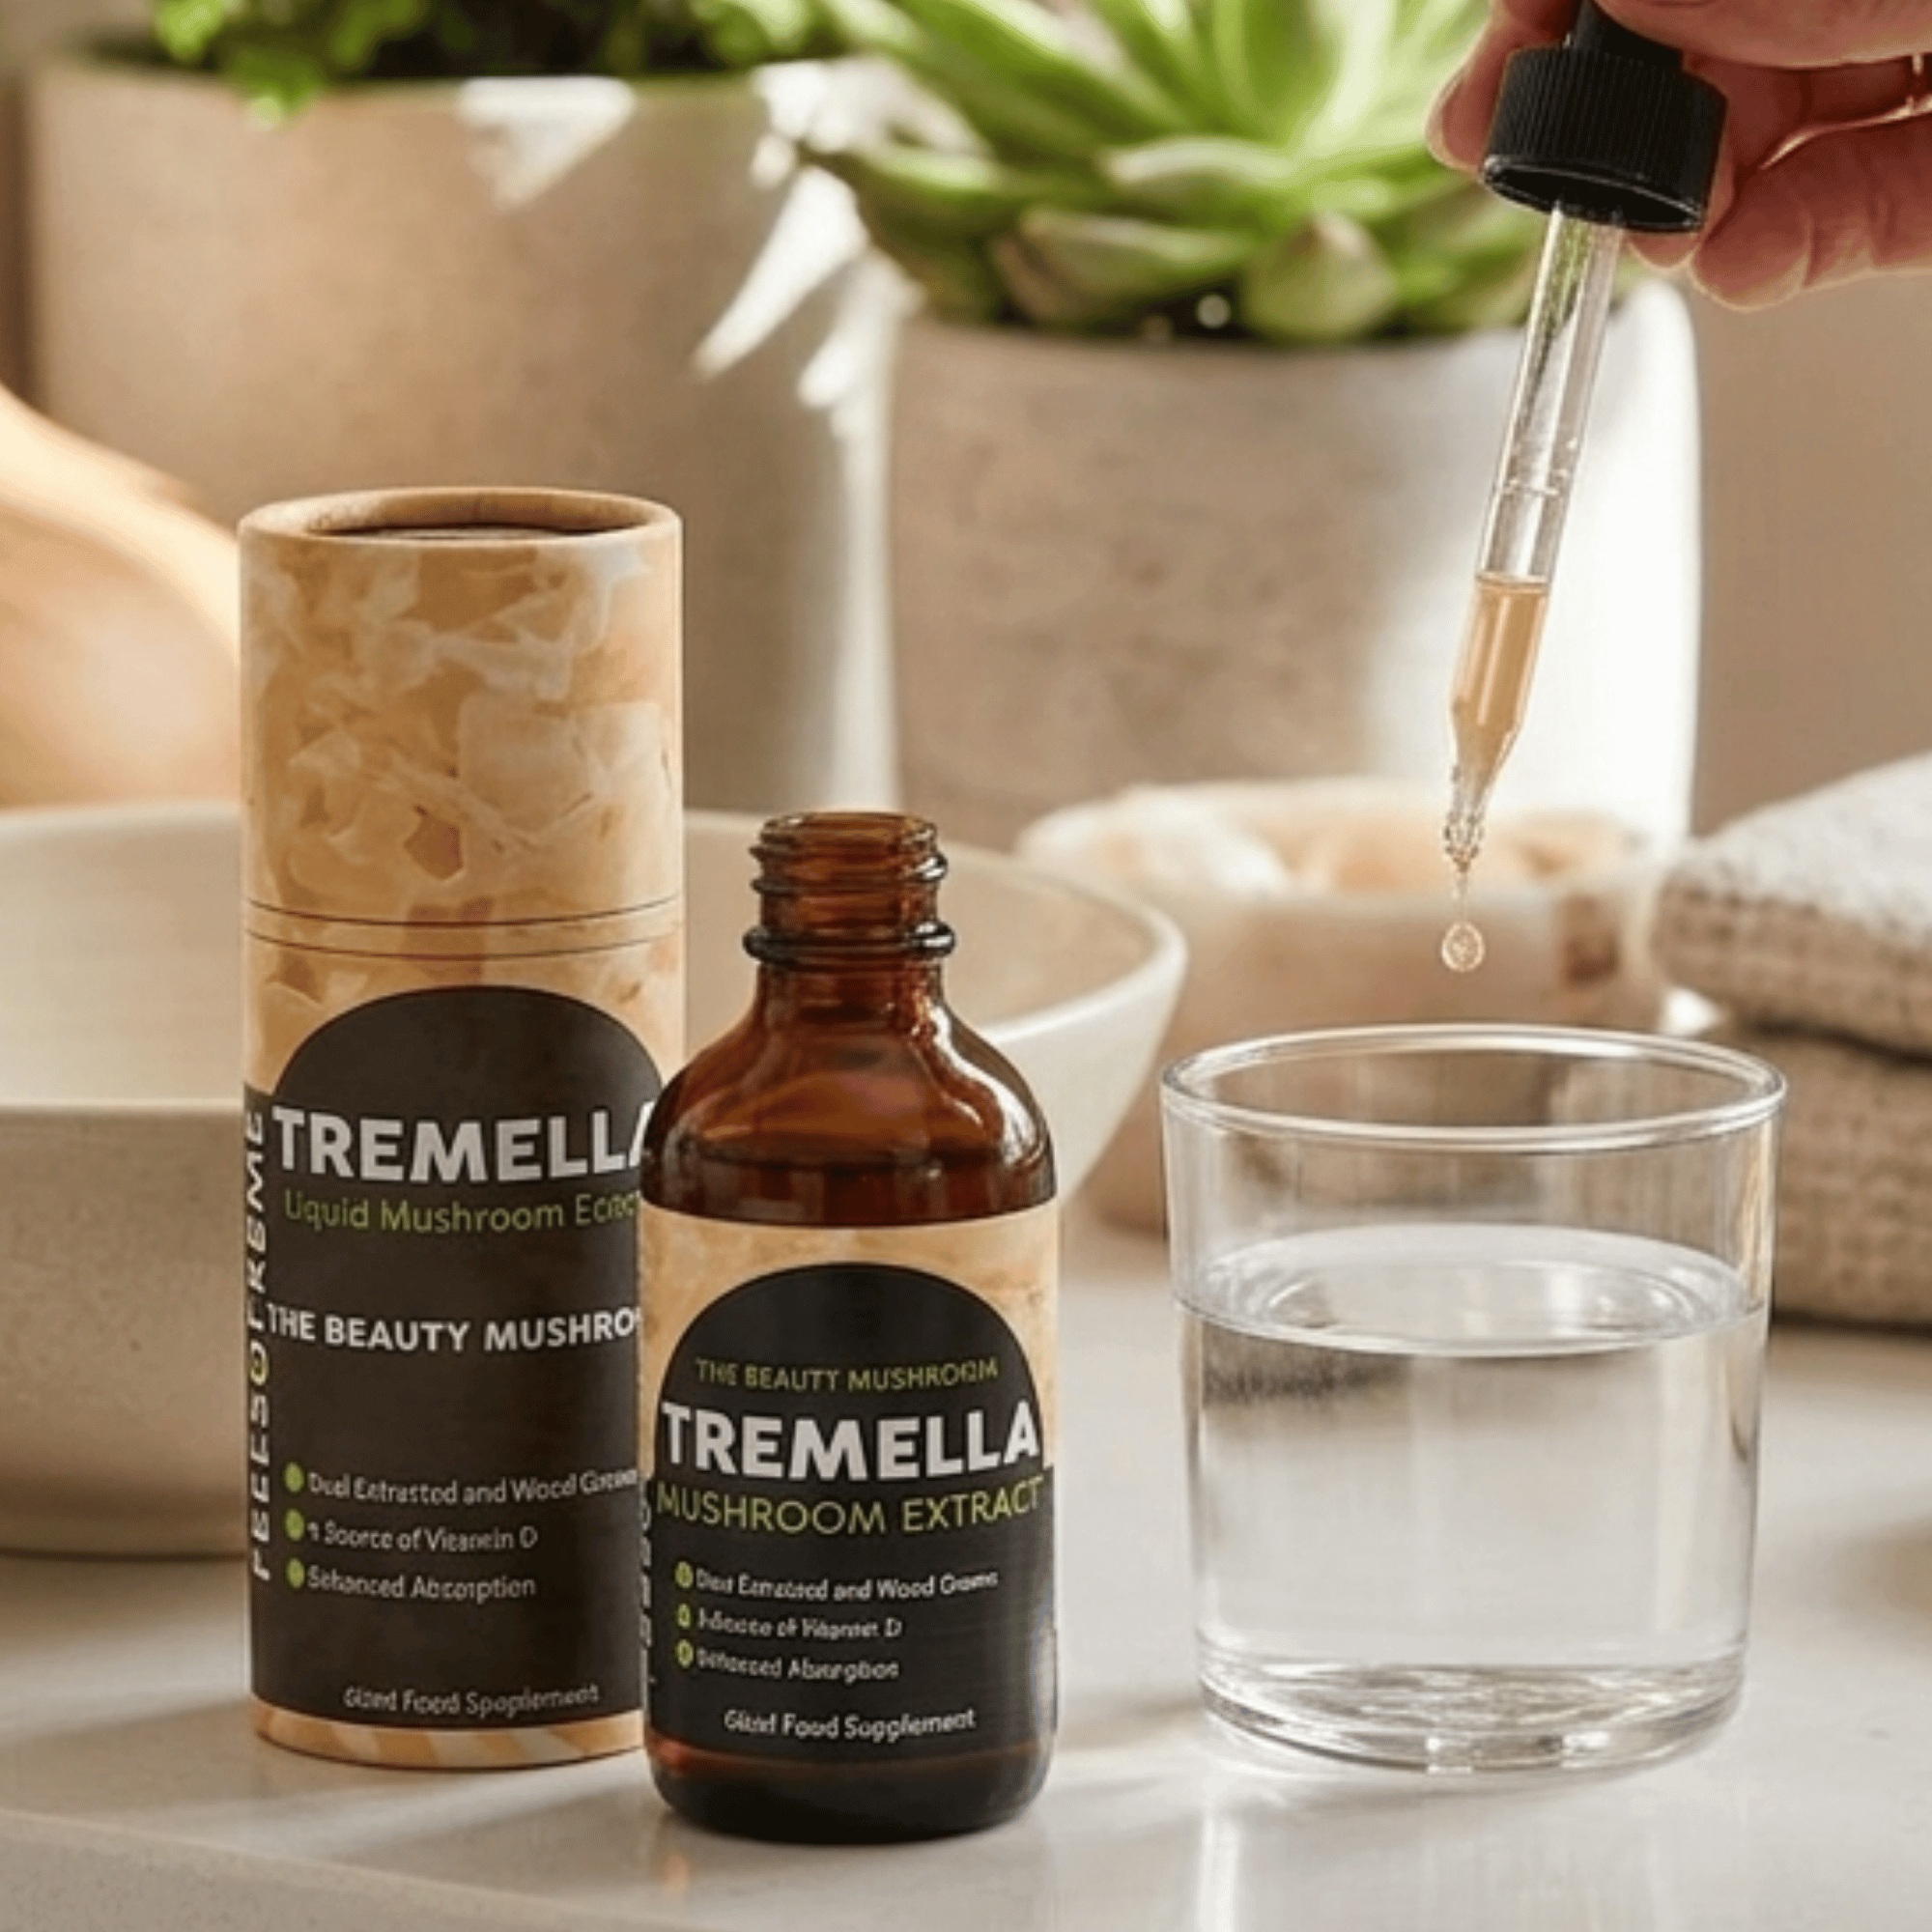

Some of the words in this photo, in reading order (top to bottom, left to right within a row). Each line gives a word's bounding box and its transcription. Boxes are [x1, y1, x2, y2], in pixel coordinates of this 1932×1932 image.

[382, 1200, 564, 1234] Mushroom
[266, 1302, 317, 1342] THE
[325, 1314, 470, 1351] BEAUTY
[485, 1307, 641, 1351] MUSHRO
[696, 1356, 737, 1385] THE
[744, 1363, 839, 1392] BEAUTY
[662, 1399, 1040, 1481] TREMELLA
[656, 1480, 887, 1535] MUSHROOM
[901, 1476, 1044, 1534] EXTRACT
